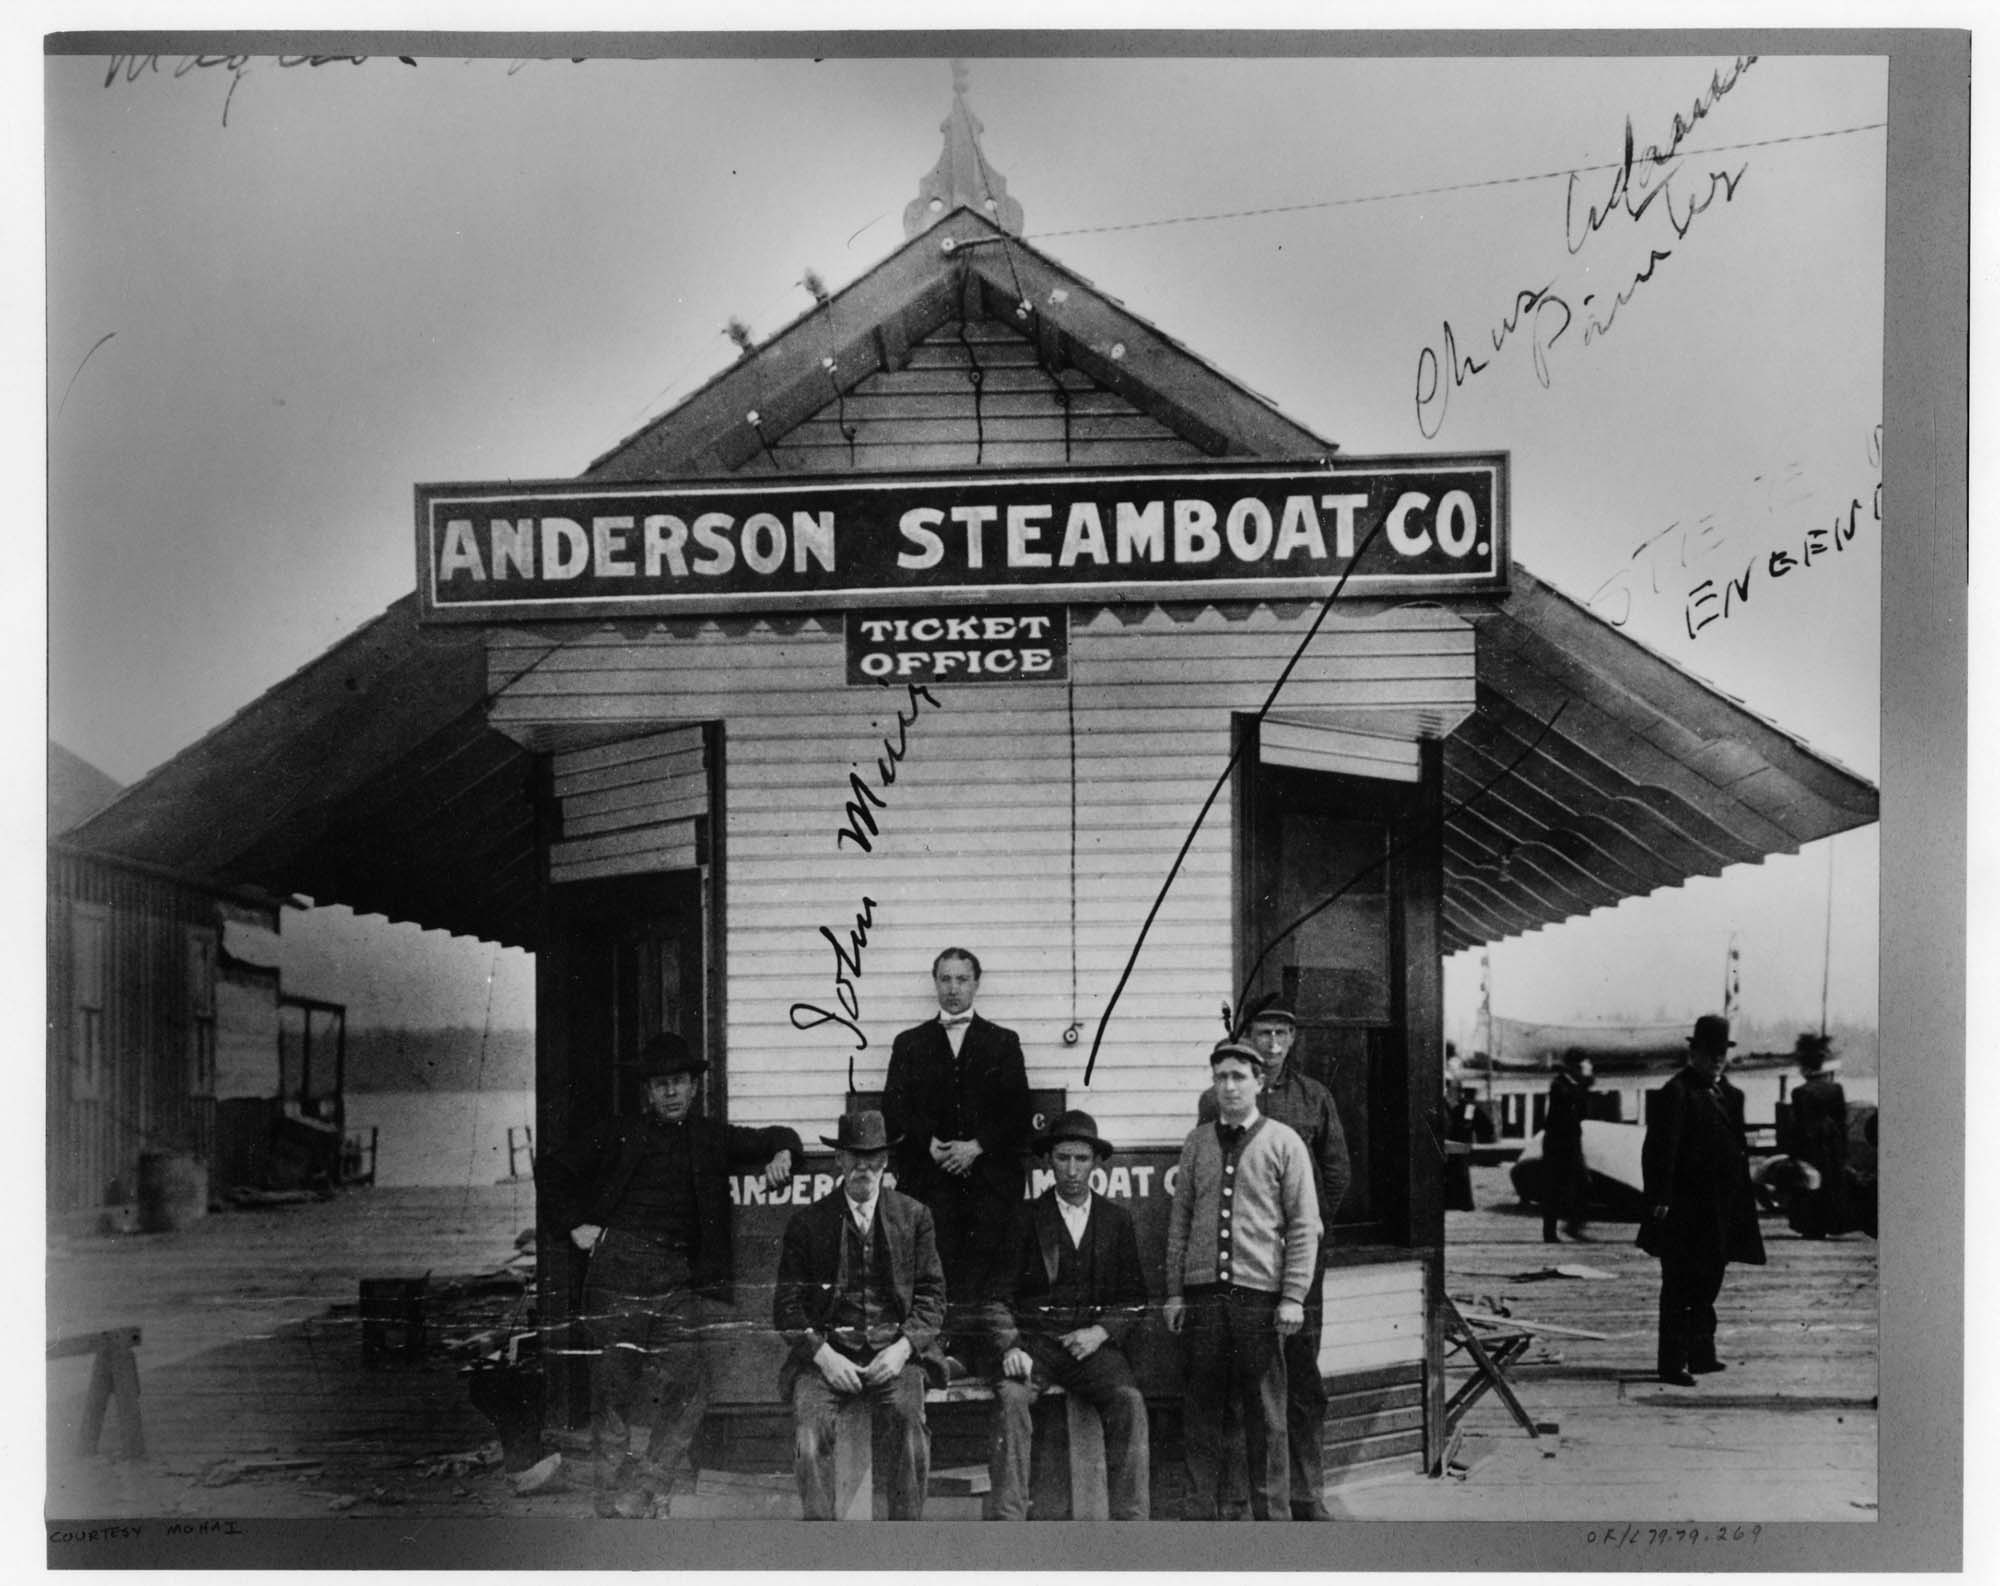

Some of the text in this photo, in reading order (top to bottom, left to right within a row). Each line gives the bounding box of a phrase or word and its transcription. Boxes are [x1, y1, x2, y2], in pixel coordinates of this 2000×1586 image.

[438, 489, 1491, 581] ANDERSON STEAMBOAT CO.
[860, 616, 1051, 641] TICKET
[860, 649, 1053, 676] OFFICE
